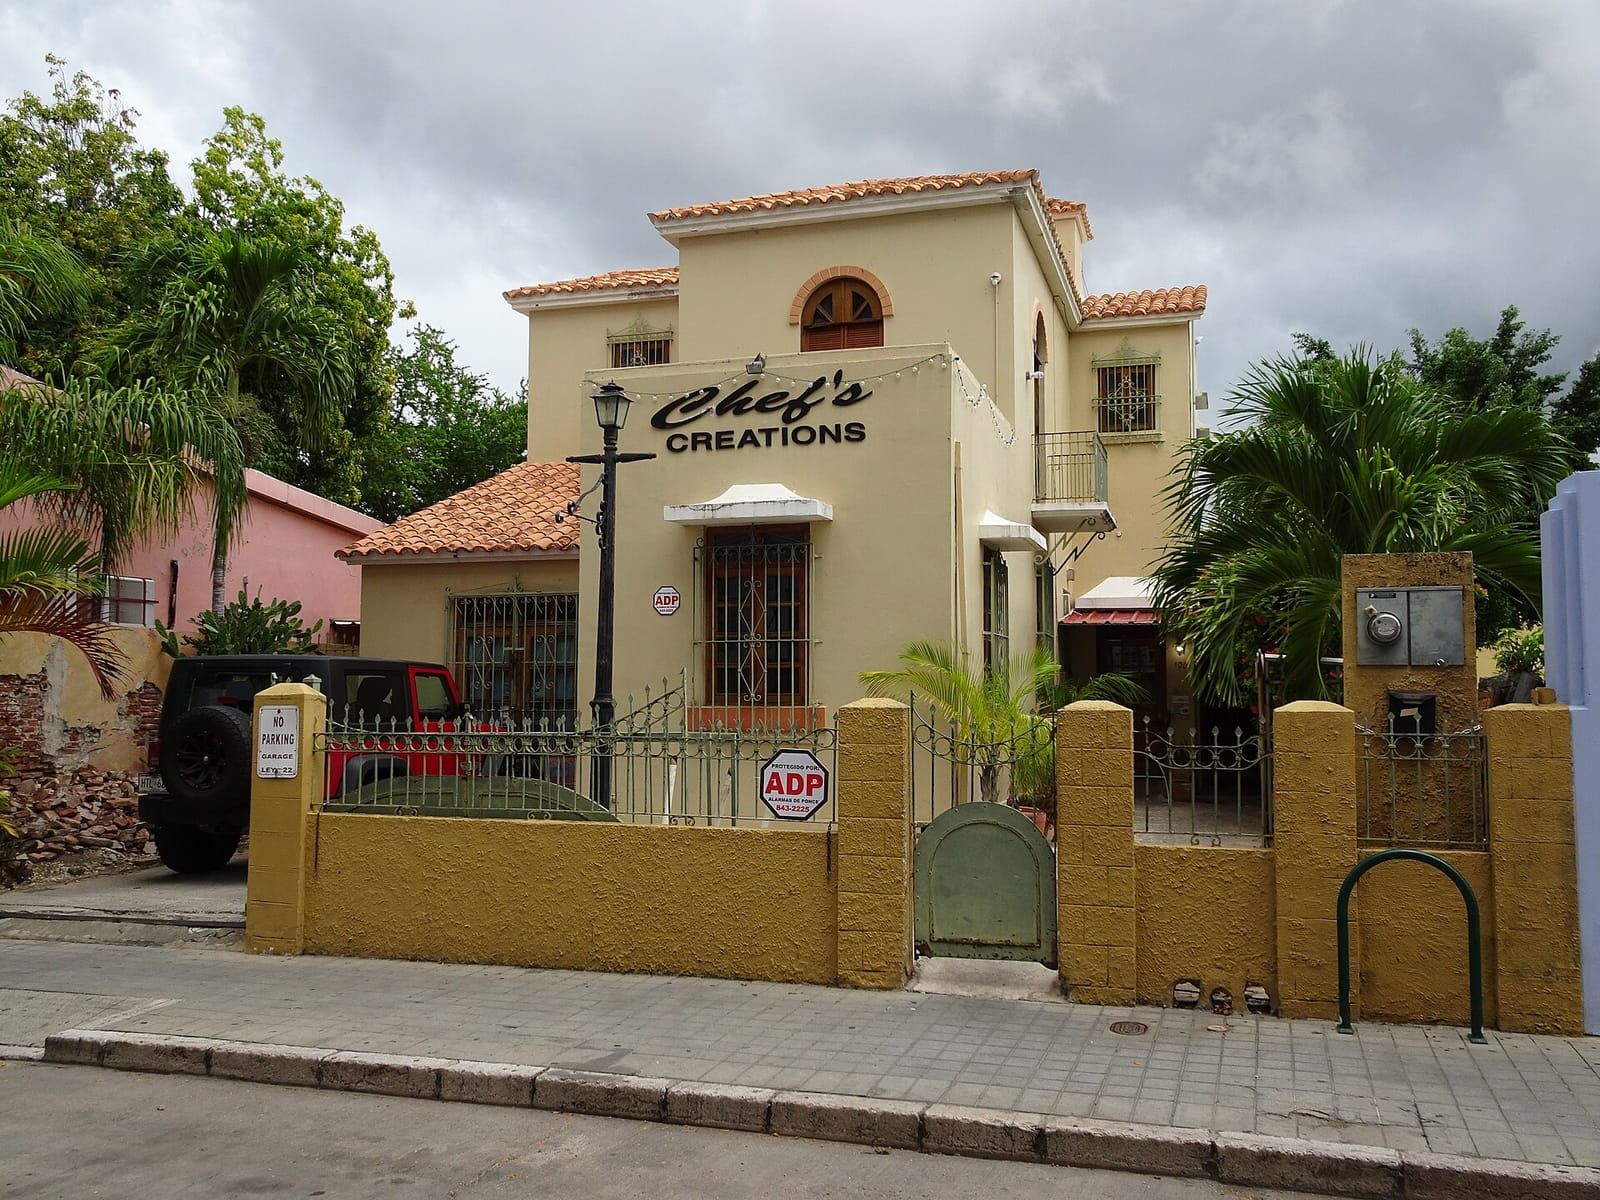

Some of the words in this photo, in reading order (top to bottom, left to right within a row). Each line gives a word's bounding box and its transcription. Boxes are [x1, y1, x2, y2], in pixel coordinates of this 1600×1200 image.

[650, 368, 873, 430] Chef's
[666, 421, 867, 454] CREATIONS
[655, 595, 679, 606] ADP
[273, 716, 284, 728] NO
[261, 733, 295, 745] PARKING
[764, 771, 824, 797] ADP
[775, 804, 810, 813] 843-2225
